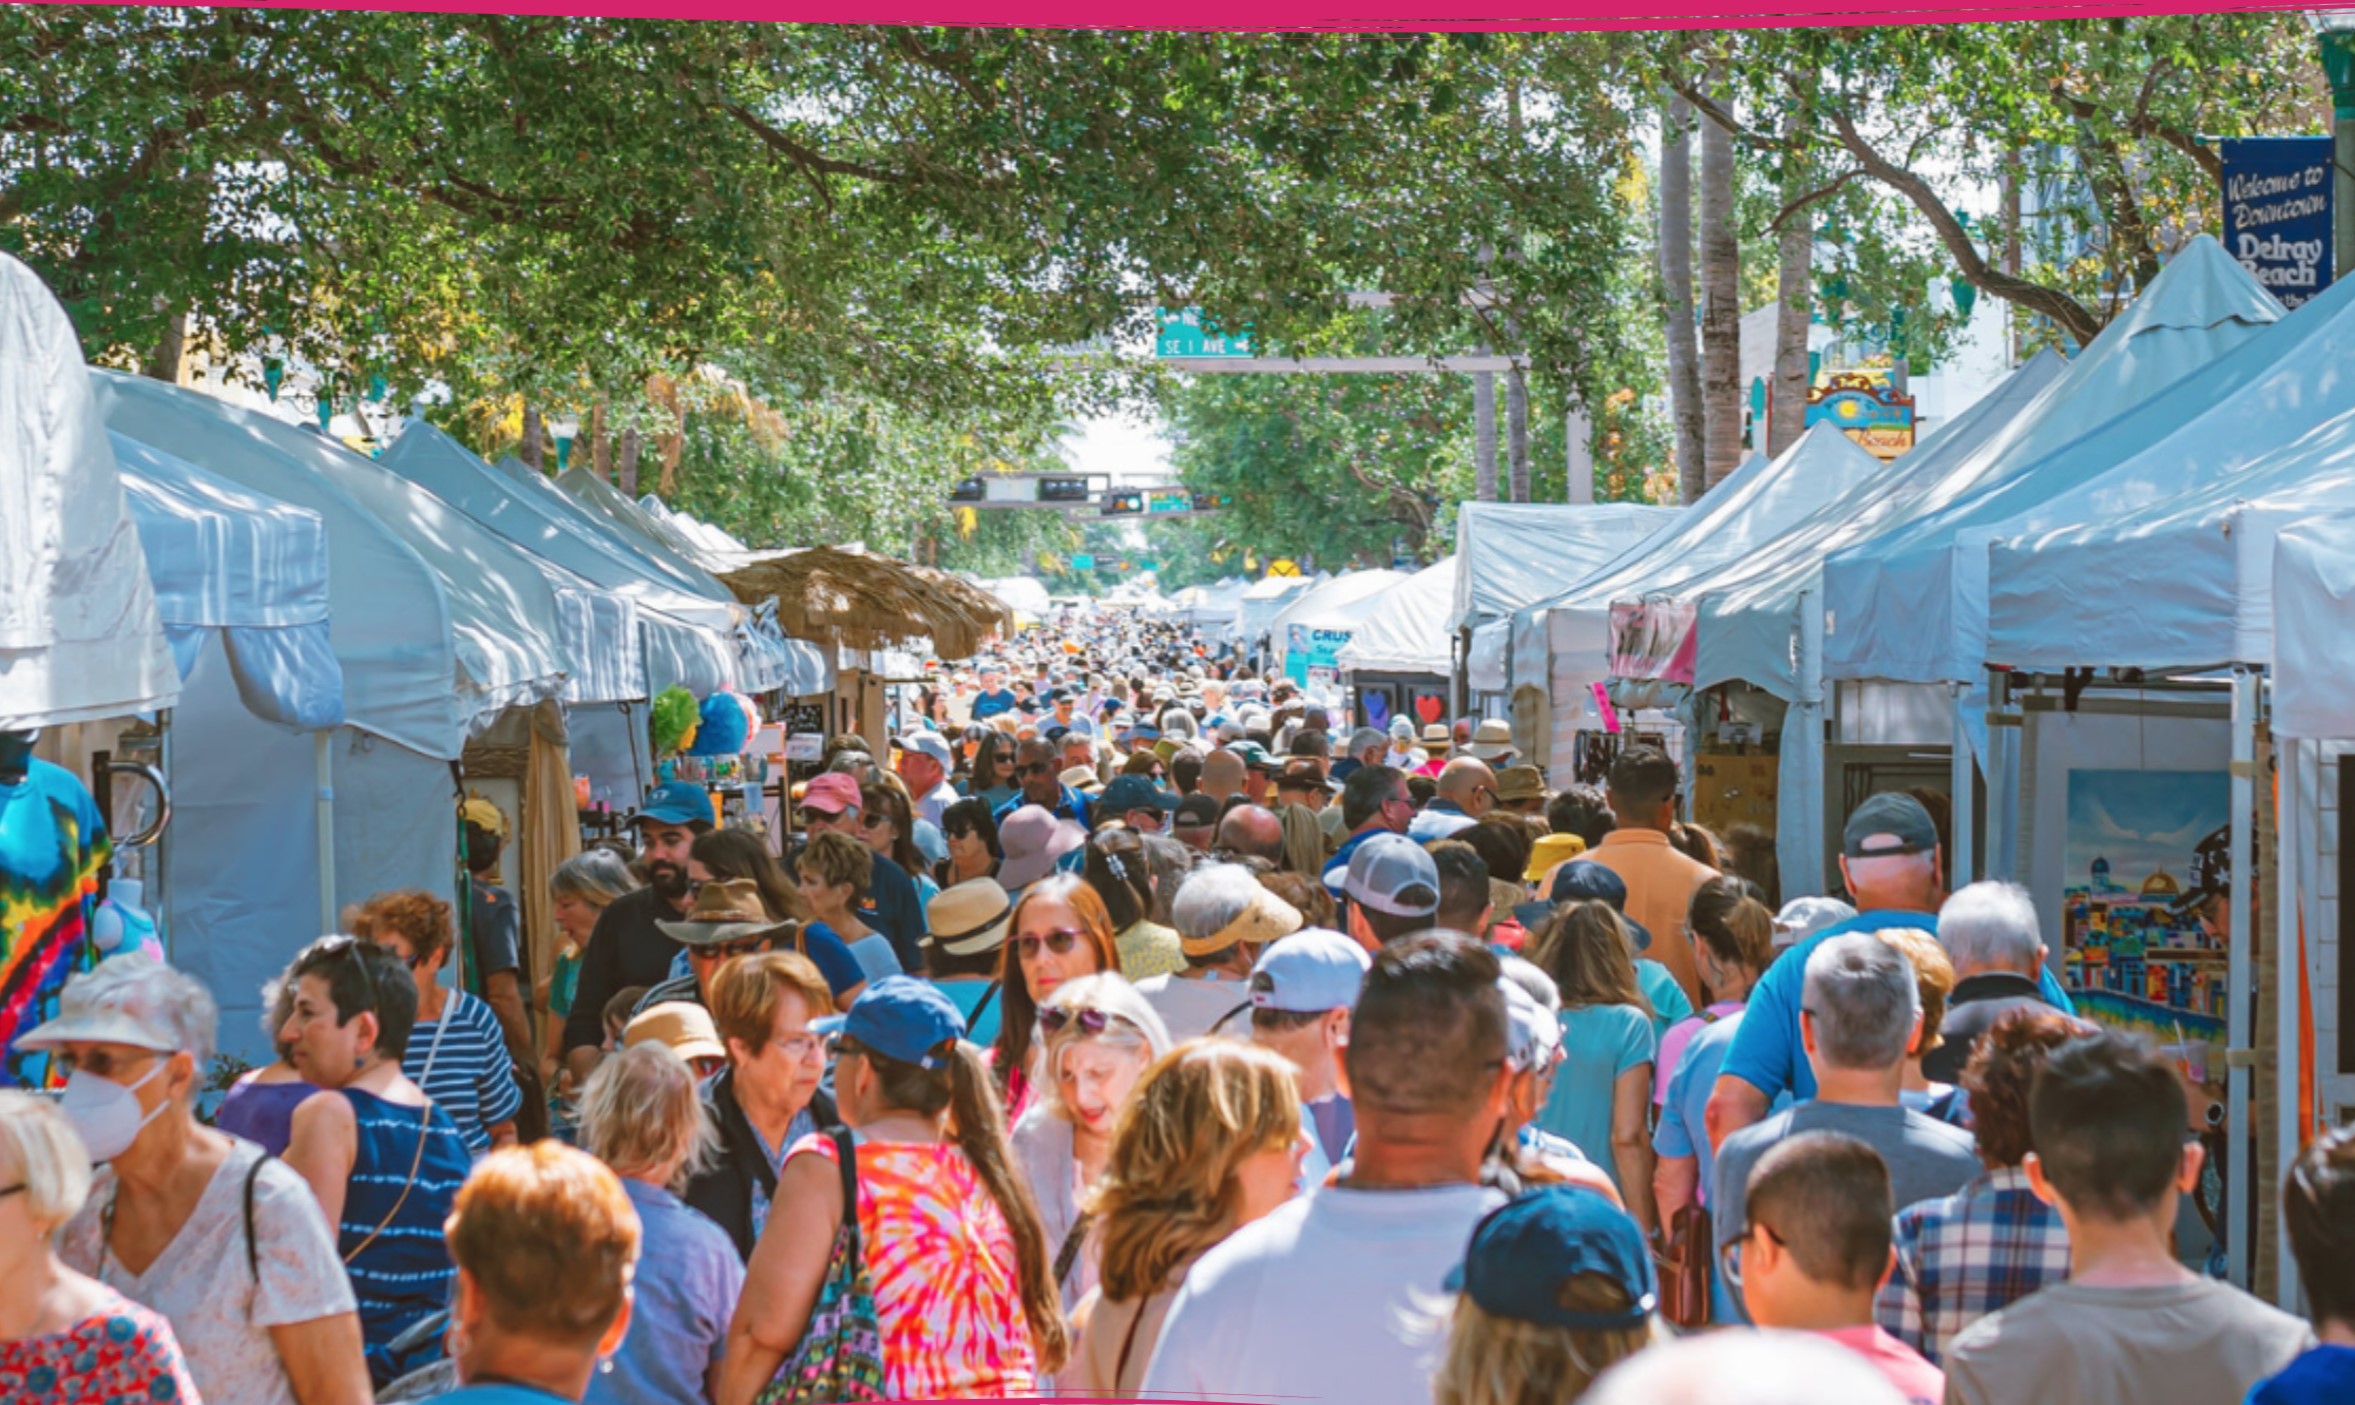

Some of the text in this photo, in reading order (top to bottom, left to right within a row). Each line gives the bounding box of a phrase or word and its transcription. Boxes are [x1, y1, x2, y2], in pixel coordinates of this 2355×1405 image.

[2228, 166, 2324, 202] Welcome to
[2233, 194, 2326, 229] Downtown
[2237, 232, 2323, 264] Delray
[1165, 339, 1181, 354] SE
[1202, 338, 1226, 354] AVE
